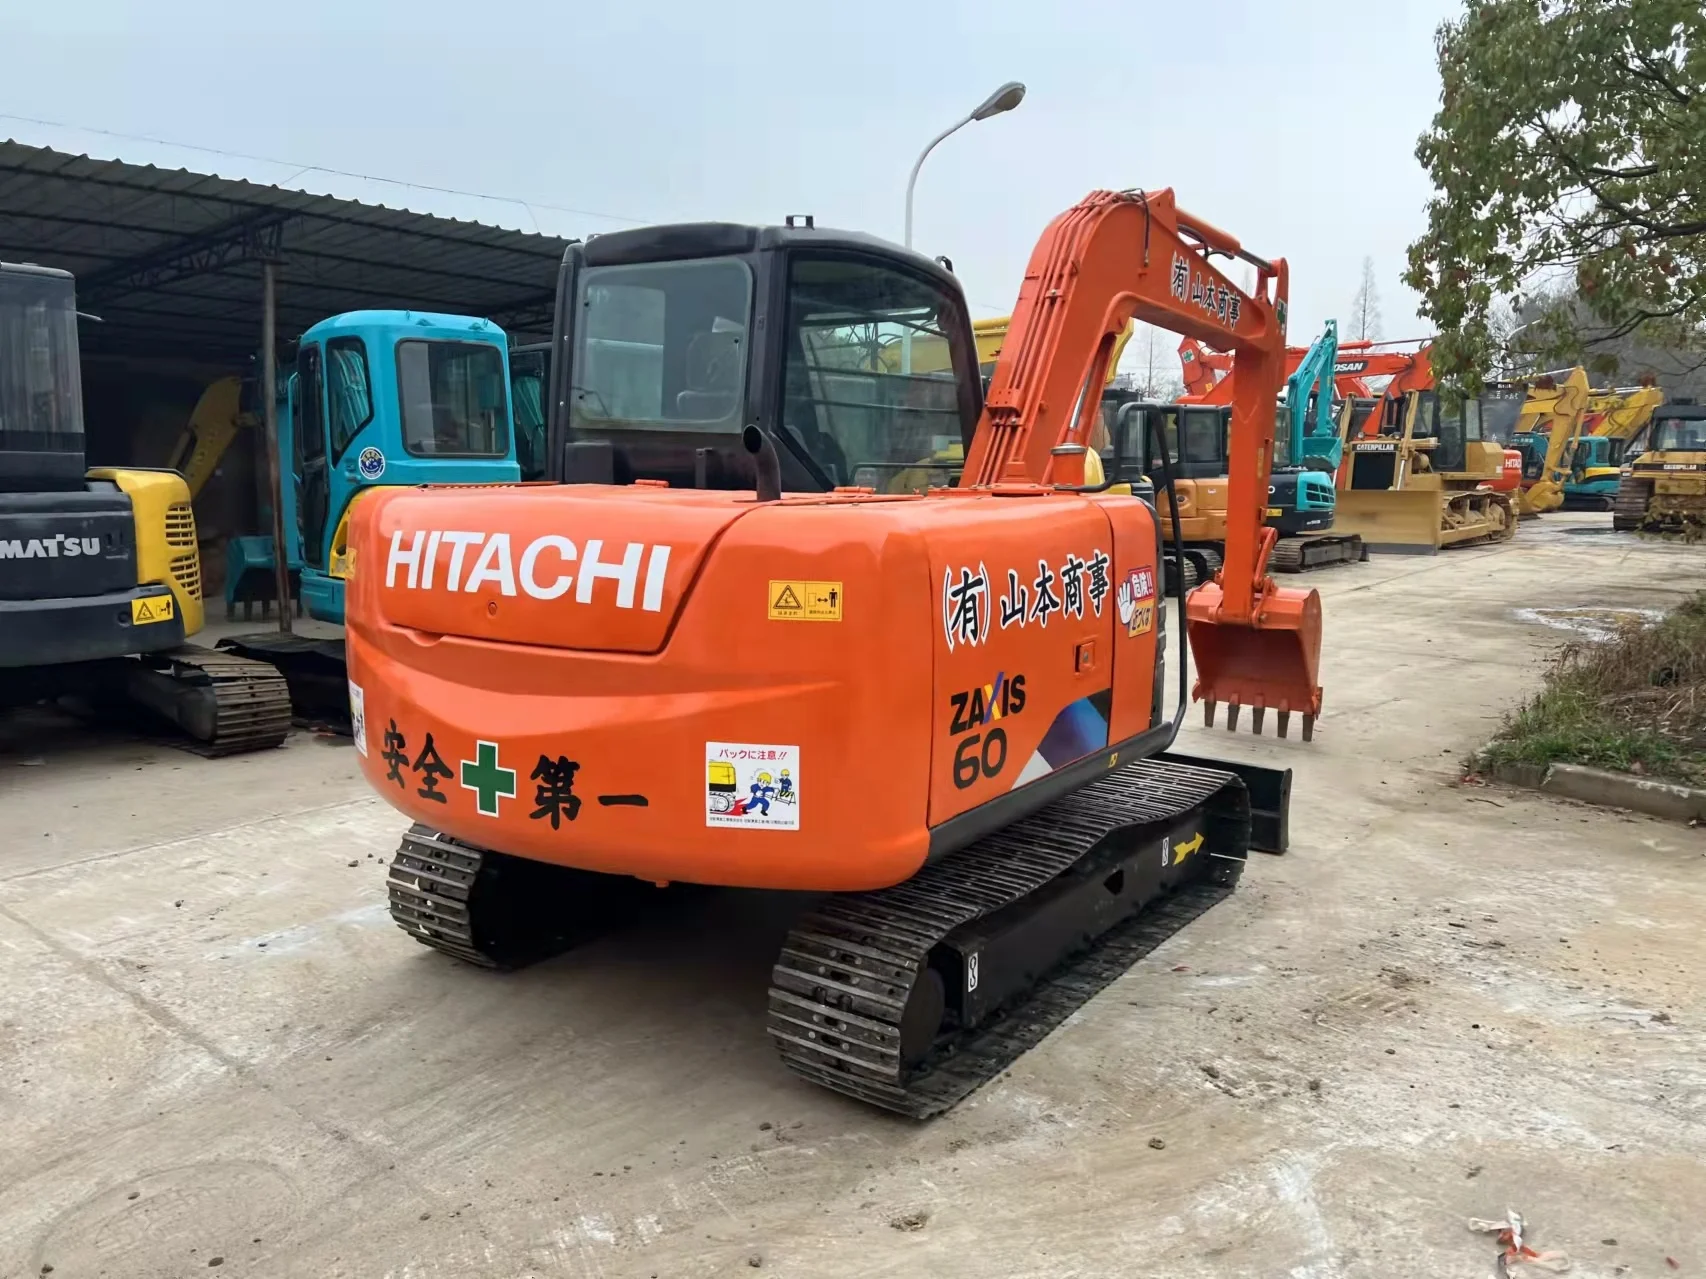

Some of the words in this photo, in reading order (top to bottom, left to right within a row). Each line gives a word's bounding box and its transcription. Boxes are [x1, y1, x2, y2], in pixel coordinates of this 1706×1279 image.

[1356, 443, 1395, 451] CATERPILLAR
[385, 530, 671, 612] HITACHI
[949, 671, 1026, 736] ZAXIS
[381, 717, 454, 804] 安全
[529, 754, 649, 831] 第一
[719, 748, 788, 760] バックに注意!!
[953, 727, 1008, 790] 60
